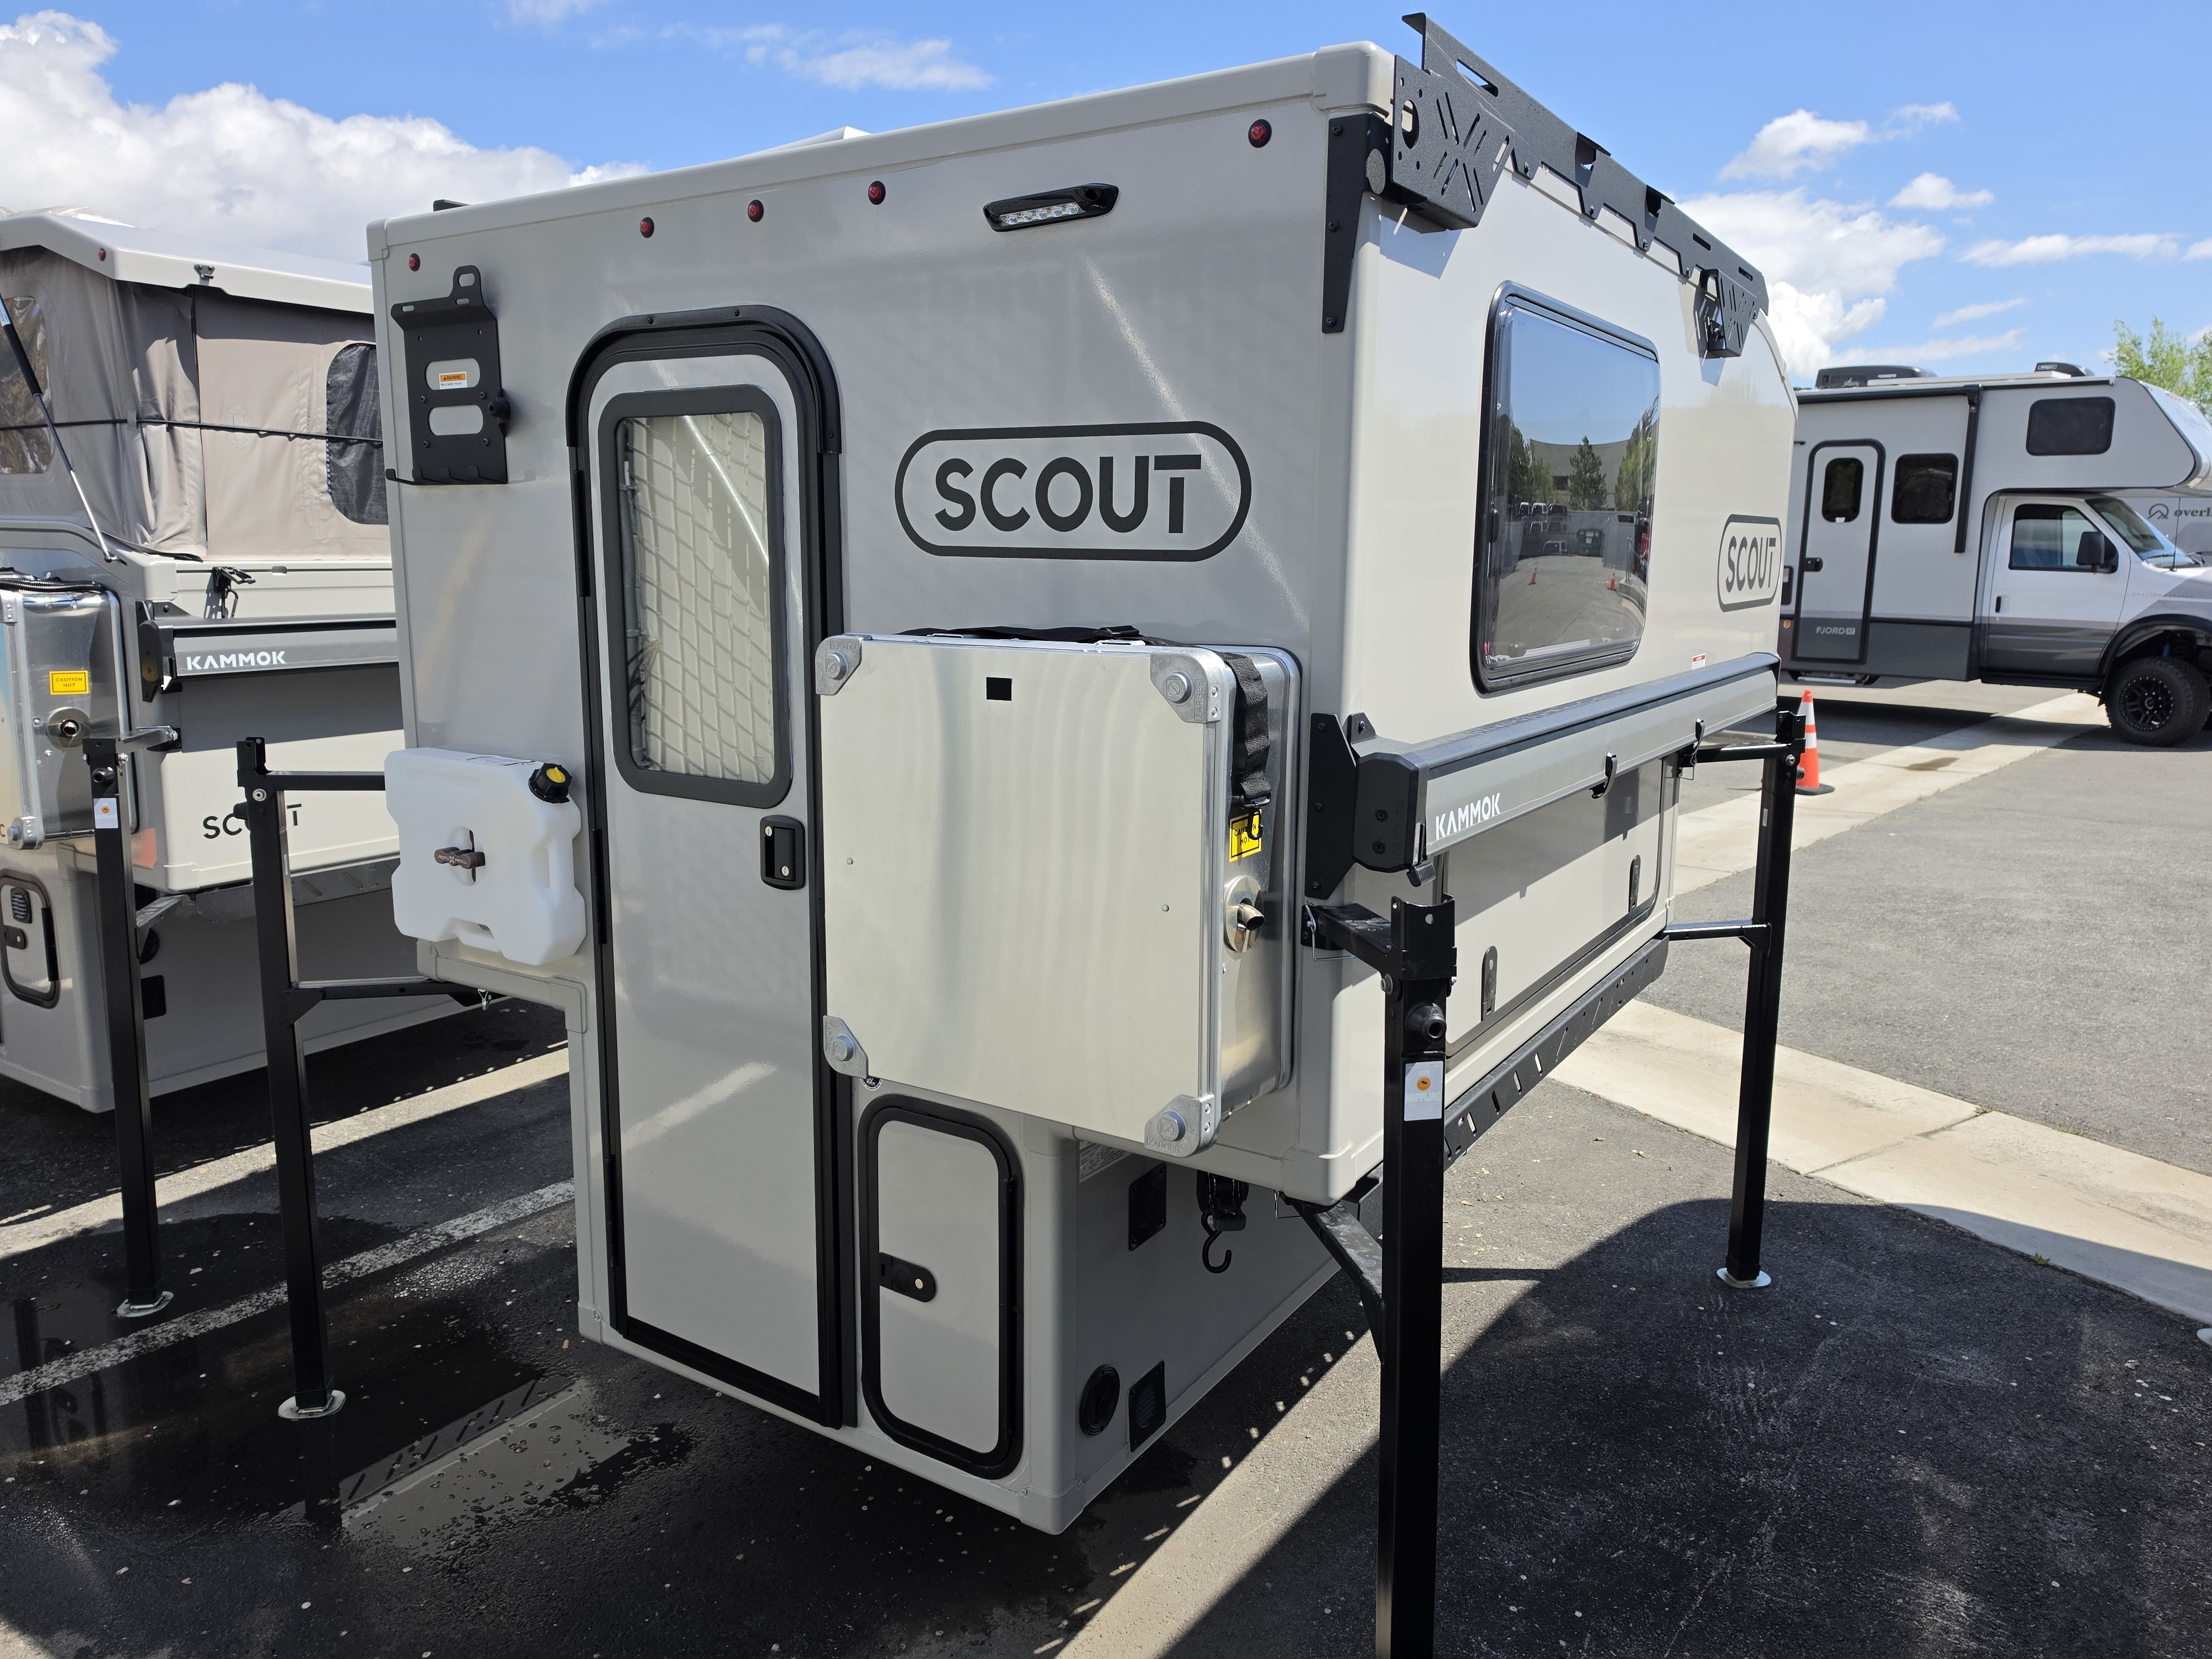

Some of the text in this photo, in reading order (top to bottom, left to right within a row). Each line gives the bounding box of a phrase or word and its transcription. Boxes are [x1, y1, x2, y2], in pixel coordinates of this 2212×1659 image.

[935, 454, 1202, 534] SCOUT
[2174, 507, 2212, 517] overl
[1725, 535, 1776, 593] SCOUT
[1816, 626, 1845, 635] FJORD
[186, 650, 286, 671] KAMMOK
[202, 804, 302, 839] SCT
[1436, 792, 1500, 841] KAMMOK
[1406, 1092, 1441, 1103] HAPPIJAC
